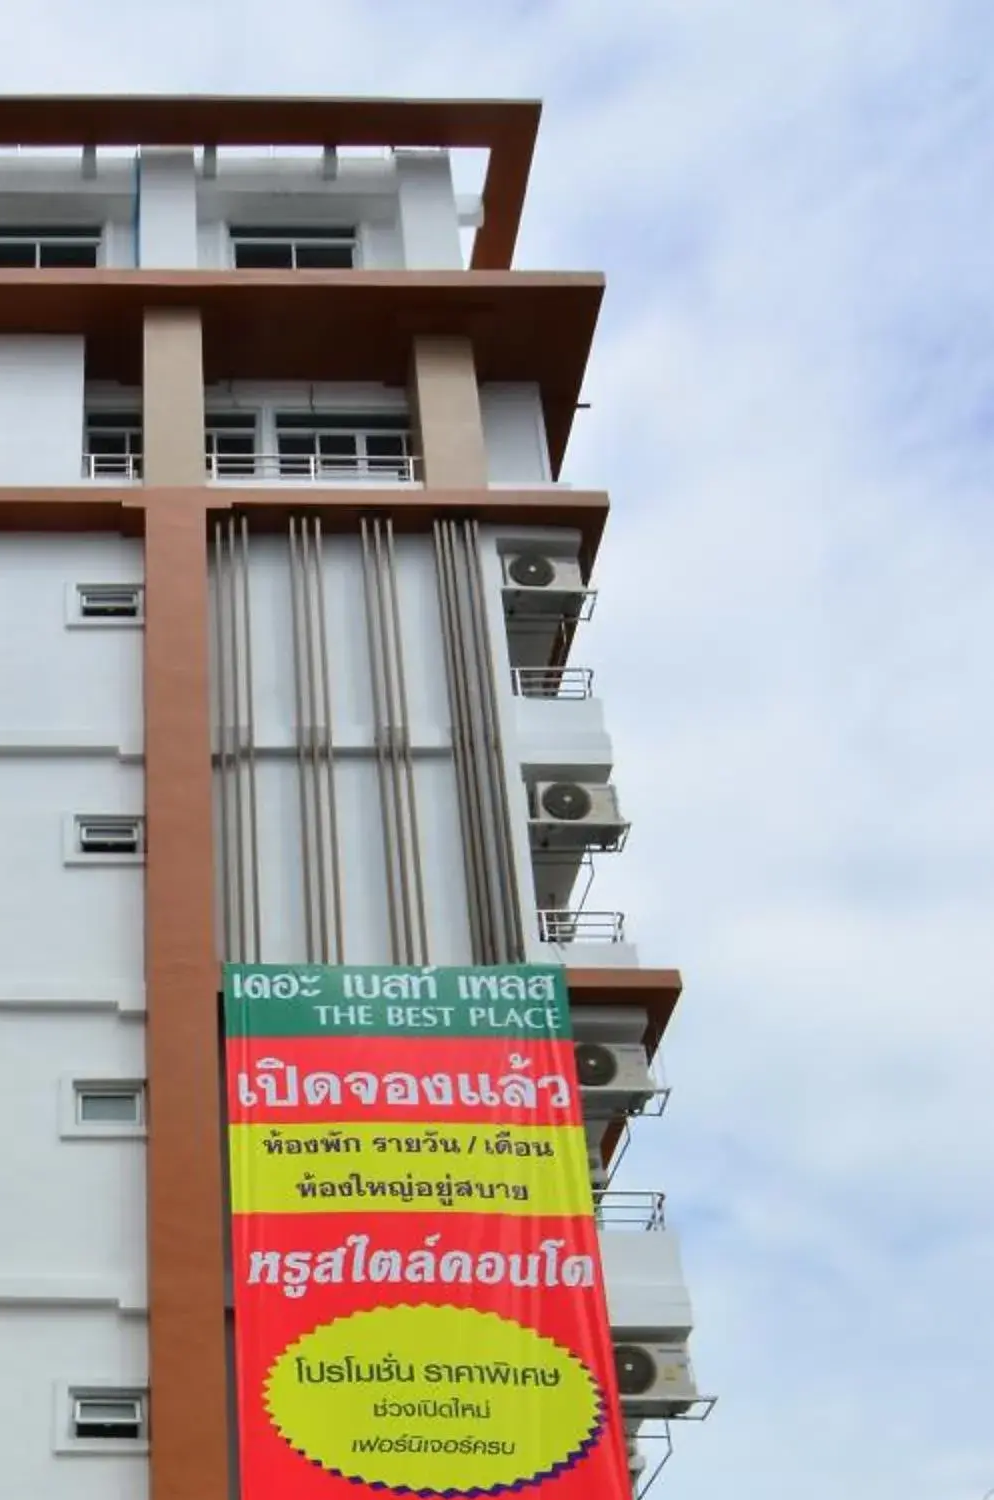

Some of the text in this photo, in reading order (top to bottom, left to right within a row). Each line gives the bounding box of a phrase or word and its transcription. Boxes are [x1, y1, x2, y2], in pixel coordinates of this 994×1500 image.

[232, 967, 556, 1001] เดอะ เบสท์ เพลส
[313, 1005, 562, 1029] THE BEST PLACE
[237, 1054, 572, 1109] เปิดจองแล้ว
[263, 1129, 361, 1155] ห้องพัก
[373, 1131, 461, 1155] รายวัน
[485, 1130, 554, 1157] เดือน
[295, 1173, 529, 1206] ห้องใหญ่อยู่สบาย
[295, 1353, 562, 1387] โปรโมชั่น ราคาพิเศษ
[373, 1398, 491, 1419] ช่วงเปิดใหม่
[351, 1434, 516, 1457] เฟอร์นิเจอร์ครบ
